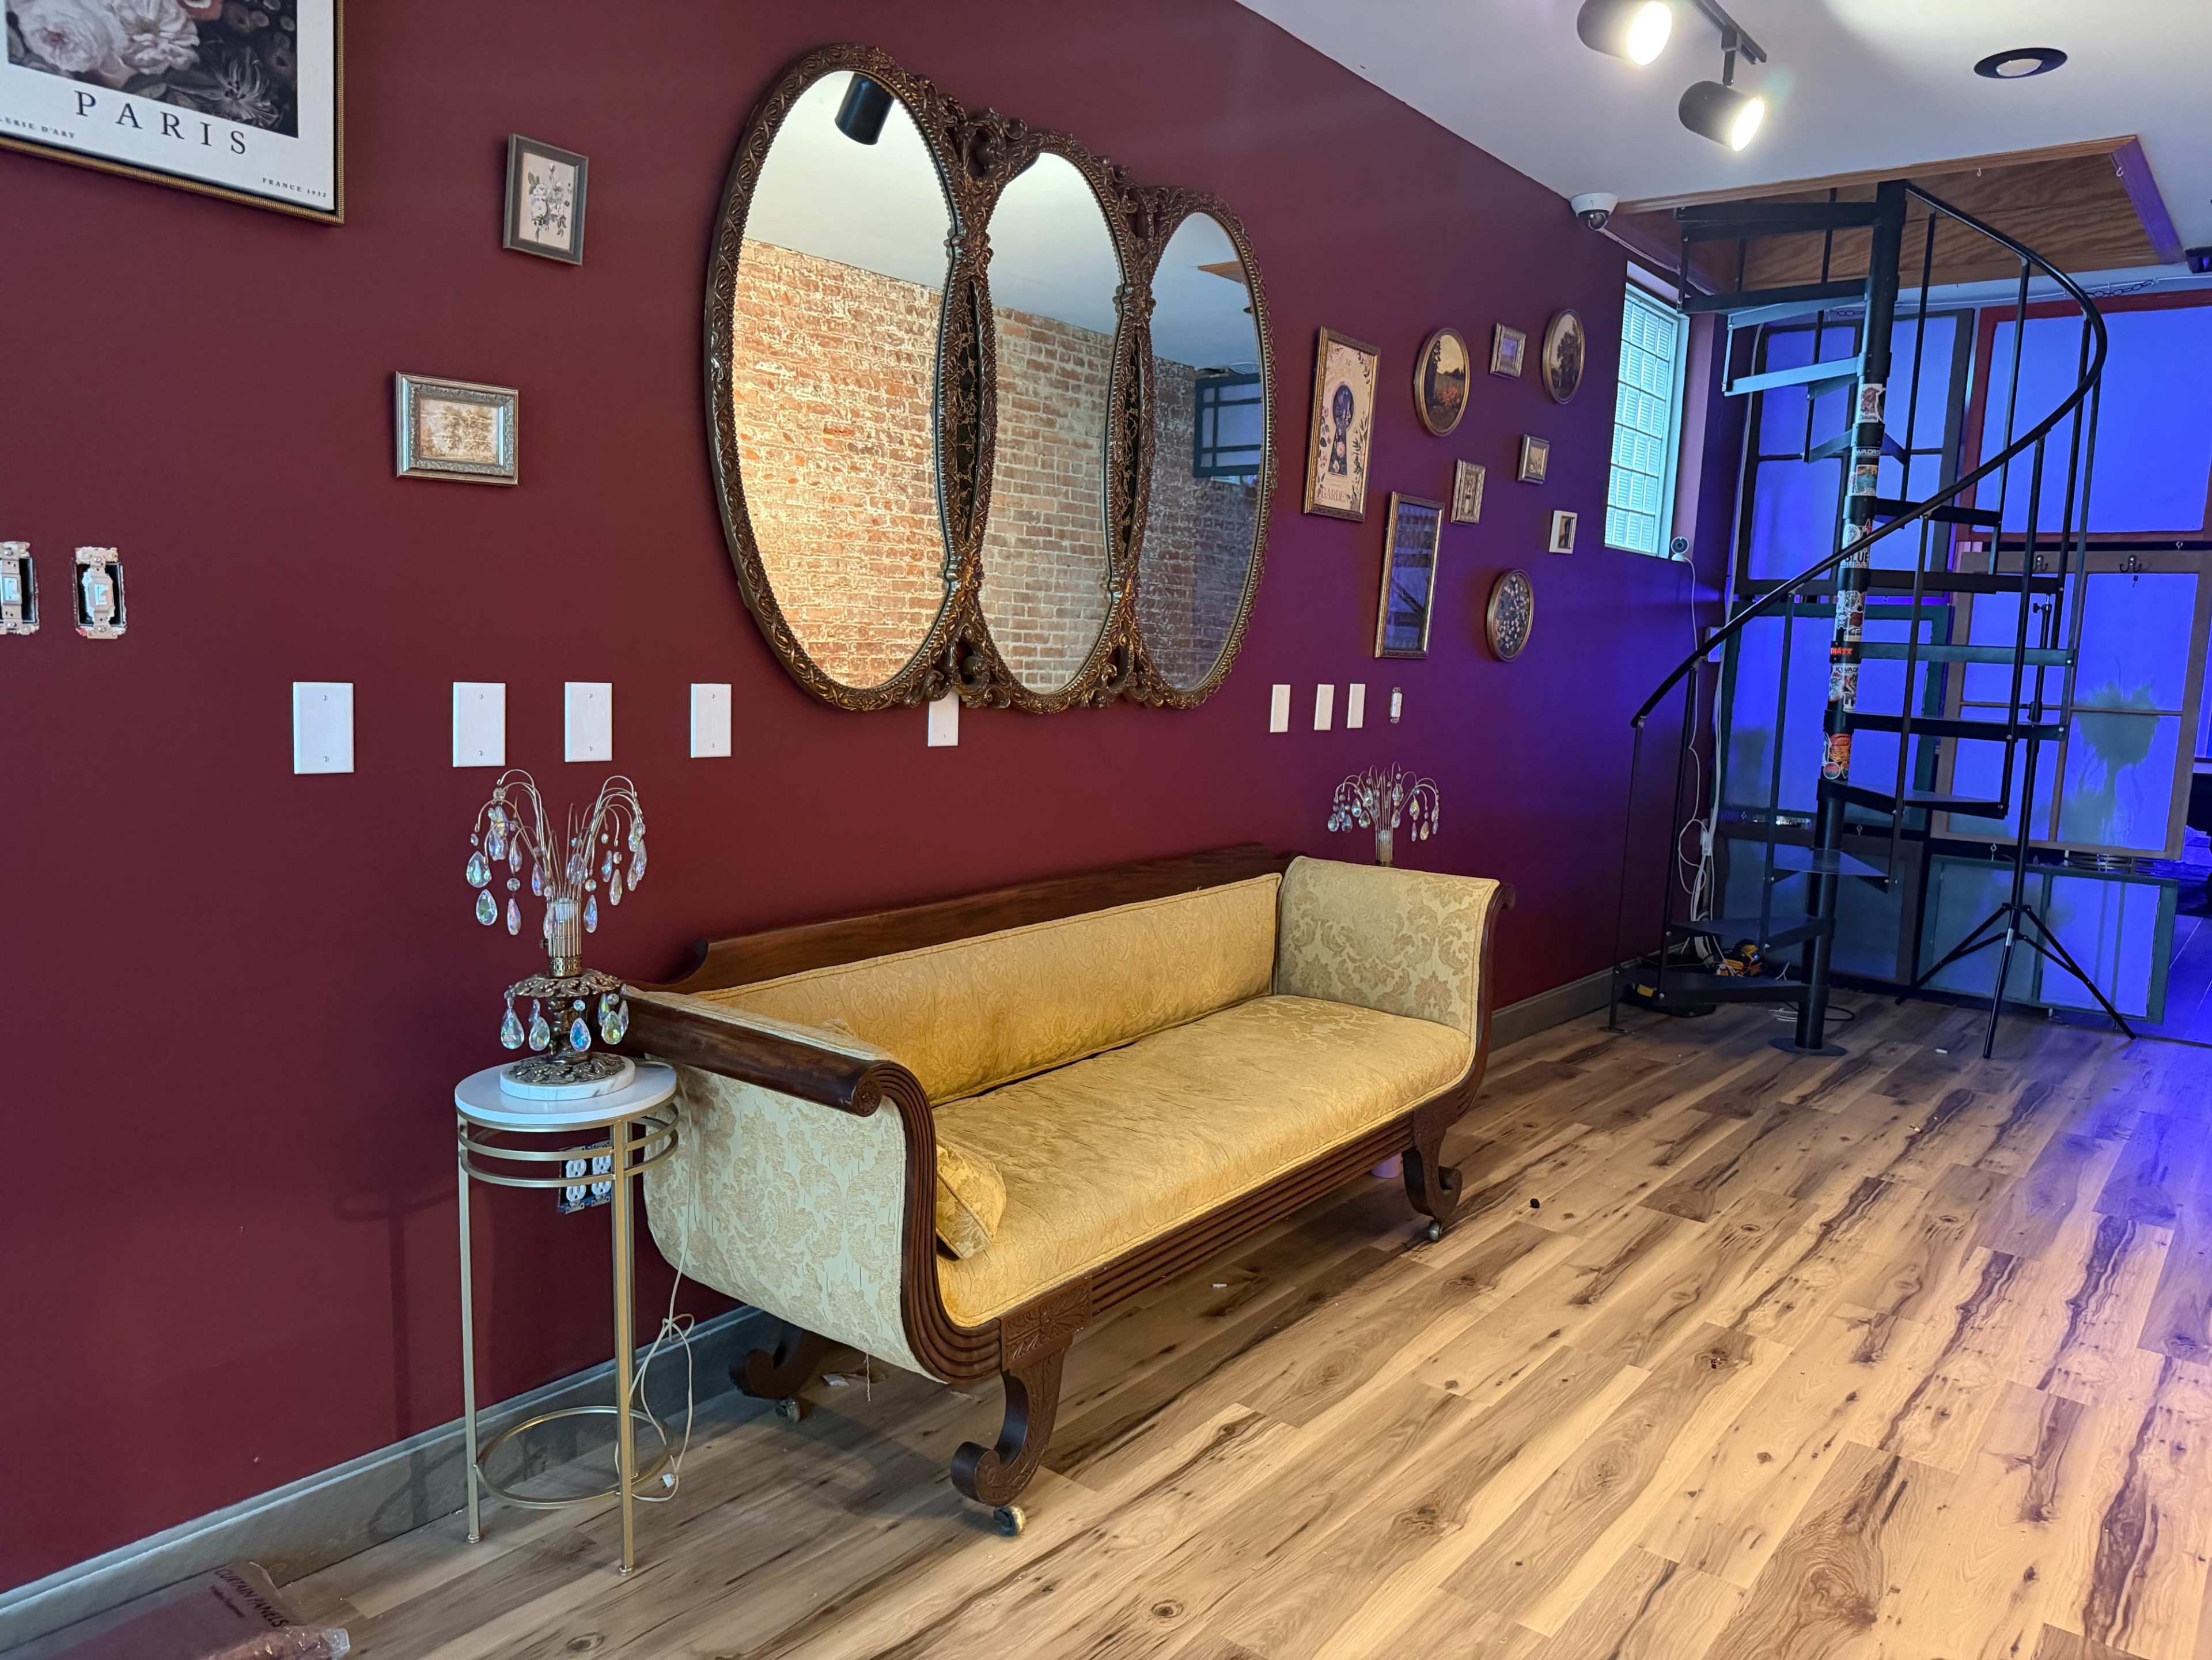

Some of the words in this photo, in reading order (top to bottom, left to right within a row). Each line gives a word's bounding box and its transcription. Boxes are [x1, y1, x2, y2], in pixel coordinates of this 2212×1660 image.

[41, 126, 75, 138] D'ART
[74, 90, 245, 154] PARIS
[263, 177, 301, 192] FRANCE
[245, 1597, 289, 1627] PANELS
